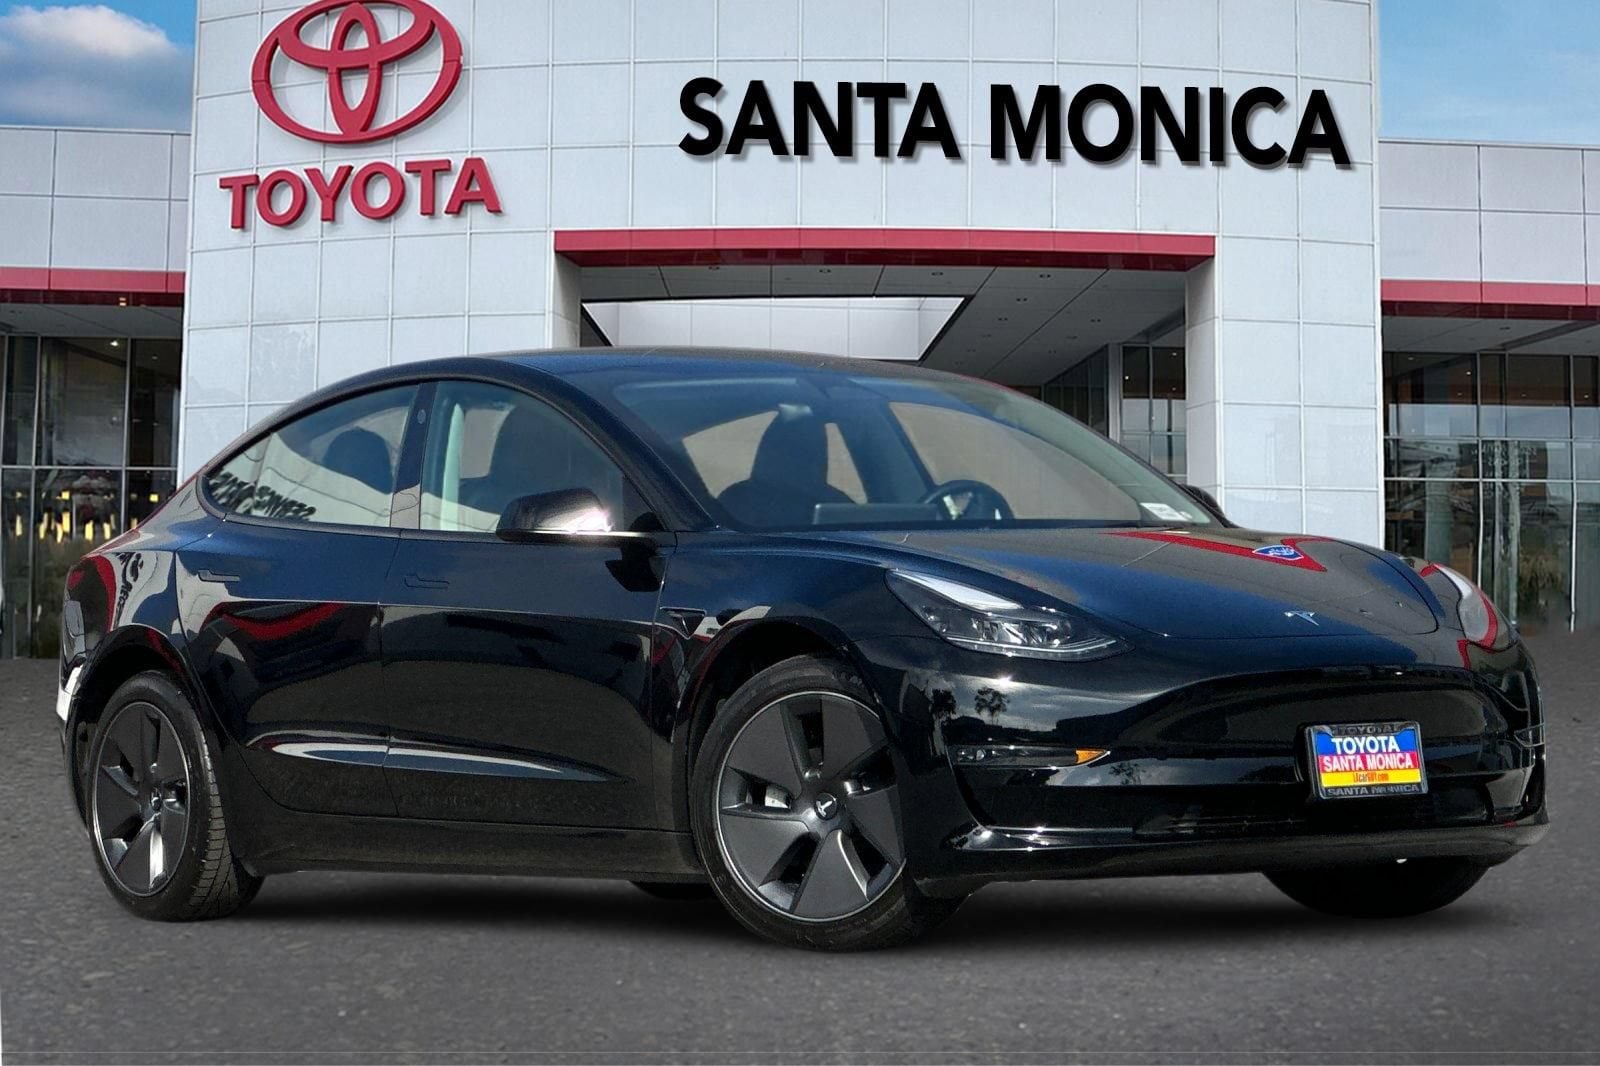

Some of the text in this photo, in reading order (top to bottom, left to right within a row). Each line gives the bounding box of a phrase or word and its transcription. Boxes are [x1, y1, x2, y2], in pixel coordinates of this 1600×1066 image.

[679, 77, 1352, 169] SANTA MONICA
[220, 157, 502, 229] TOYOTA
[1331, 736, 1400, 754] TOYOTA
[1323, 752, 1413, 772] SANTA MONICA
[1327, 787, 1369, 796] SANTA
